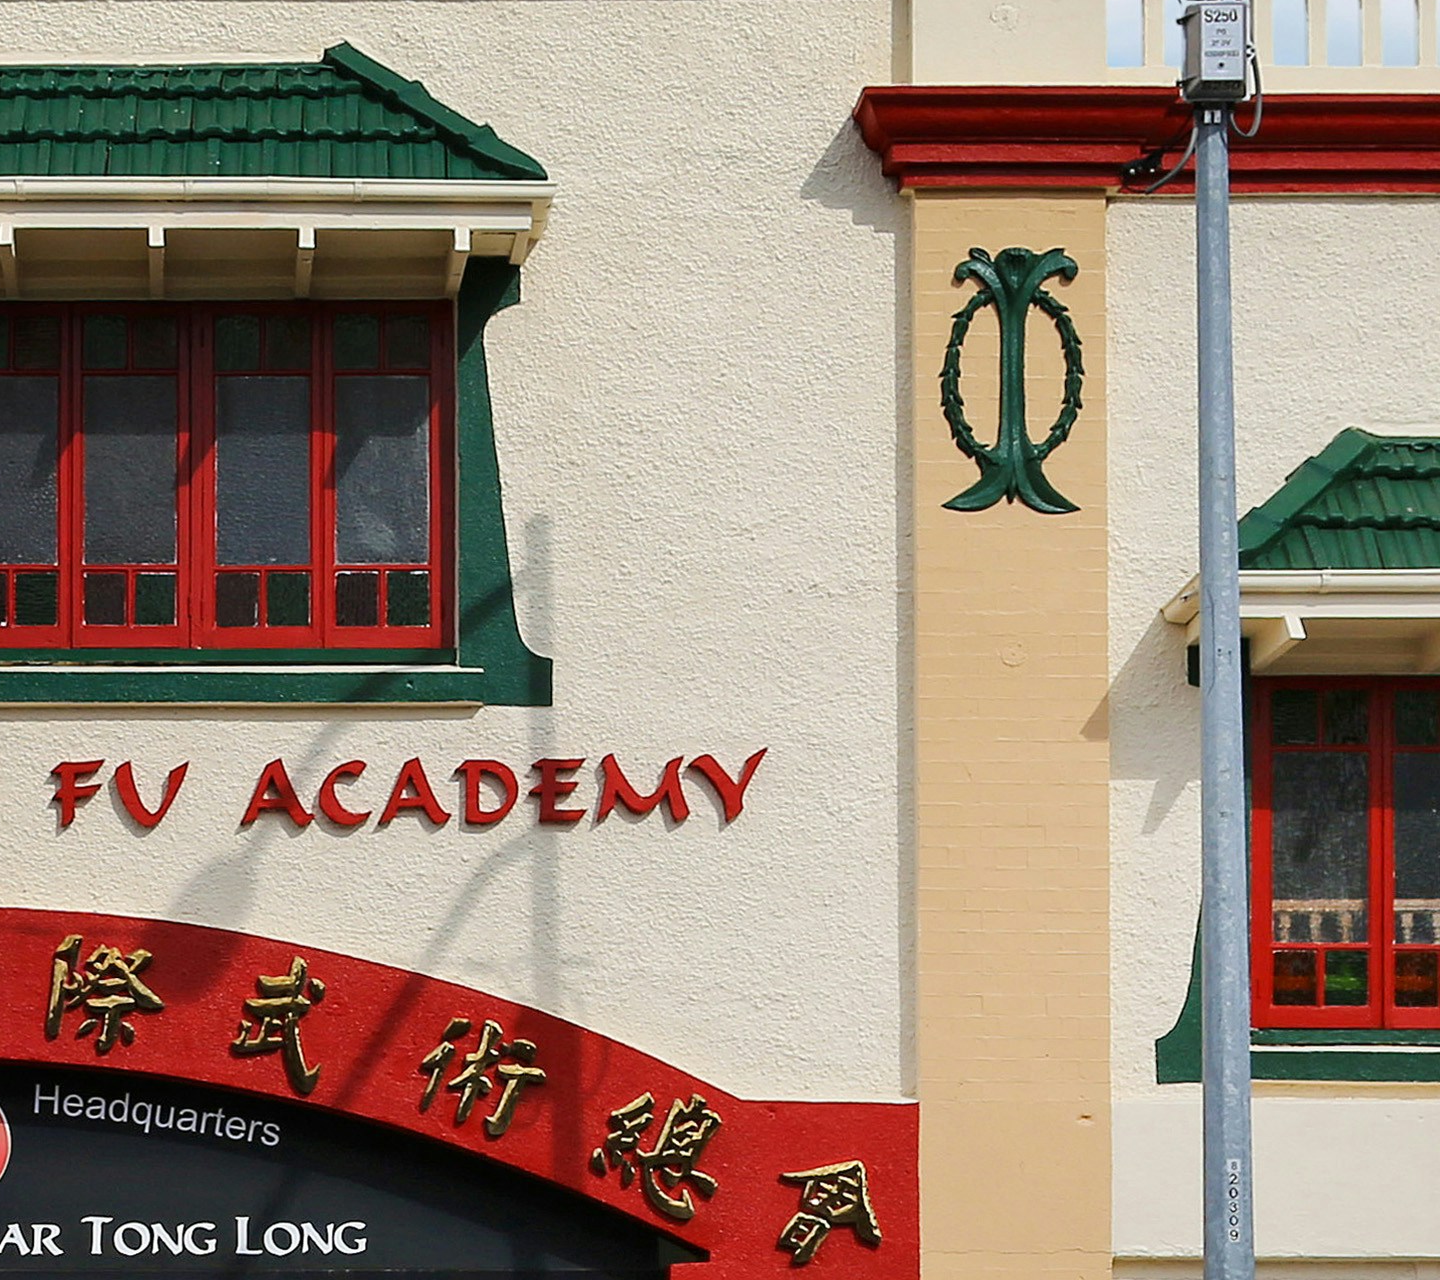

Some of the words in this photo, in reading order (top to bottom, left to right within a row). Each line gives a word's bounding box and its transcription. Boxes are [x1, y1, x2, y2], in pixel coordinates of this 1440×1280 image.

[1204, 8, 1238, 23] S250
[49, 759, 189, 829] FU
[239, 747, 768, 829] ACADEMY
[32, 1083, 283, 1148] Headquarters
[81, 1215, 218, 1258] TONG
[234, 1215, 368, 1258] LONG
